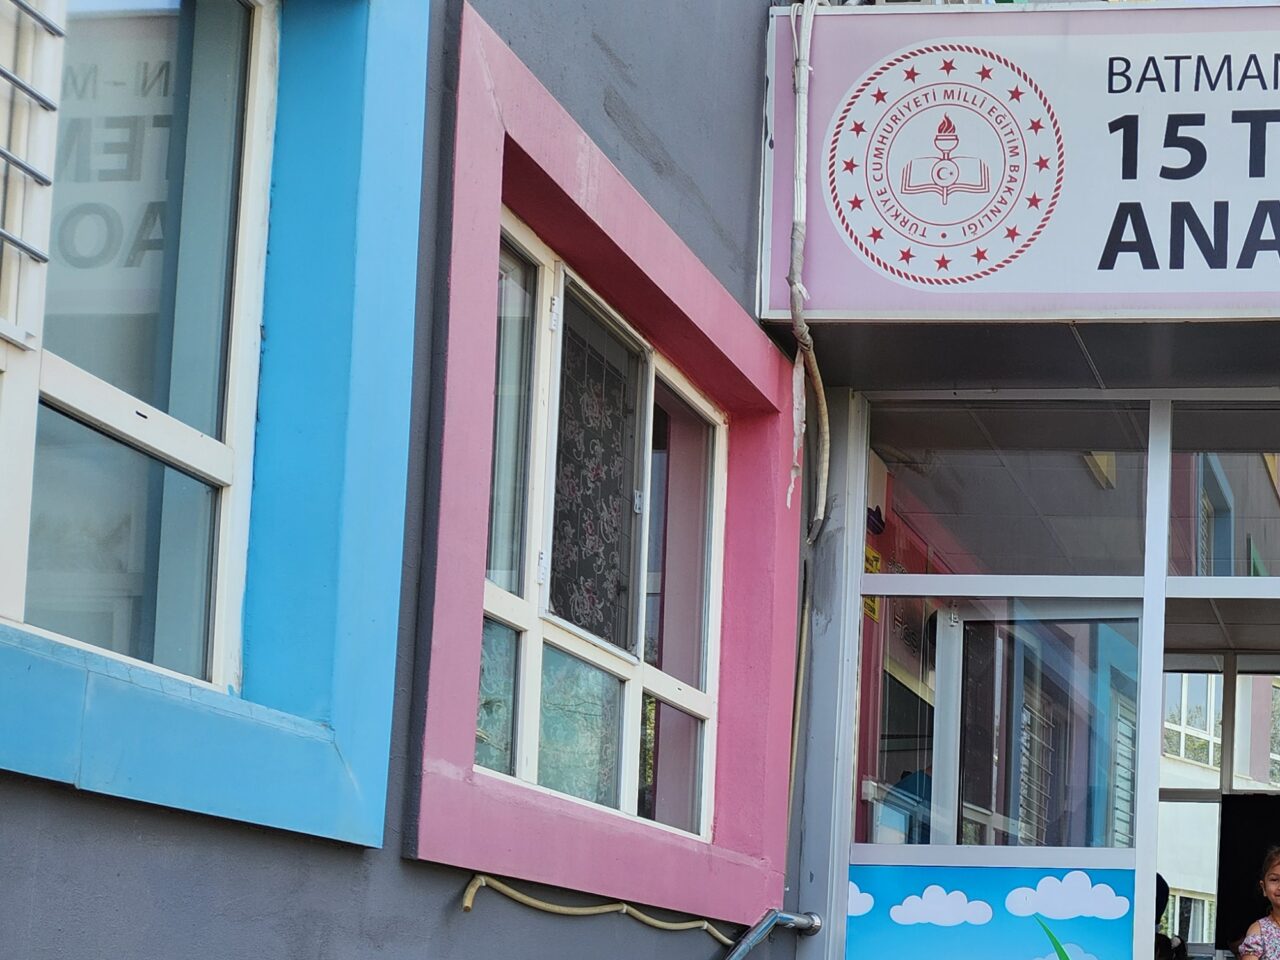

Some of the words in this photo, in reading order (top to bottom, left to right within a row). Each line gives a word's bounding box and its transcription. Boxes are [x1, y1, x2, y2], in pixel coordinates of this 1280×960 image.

[872, 90, 937, 182] CUMHURİYETİ
[988, 105, 1020, 158] EĞİTİM
[1107, 113, 1207, 181] 15
[876, 187, 927, 239] TÜRKİYE
[961, 164, 1020, 238] BAKANLIĞI
